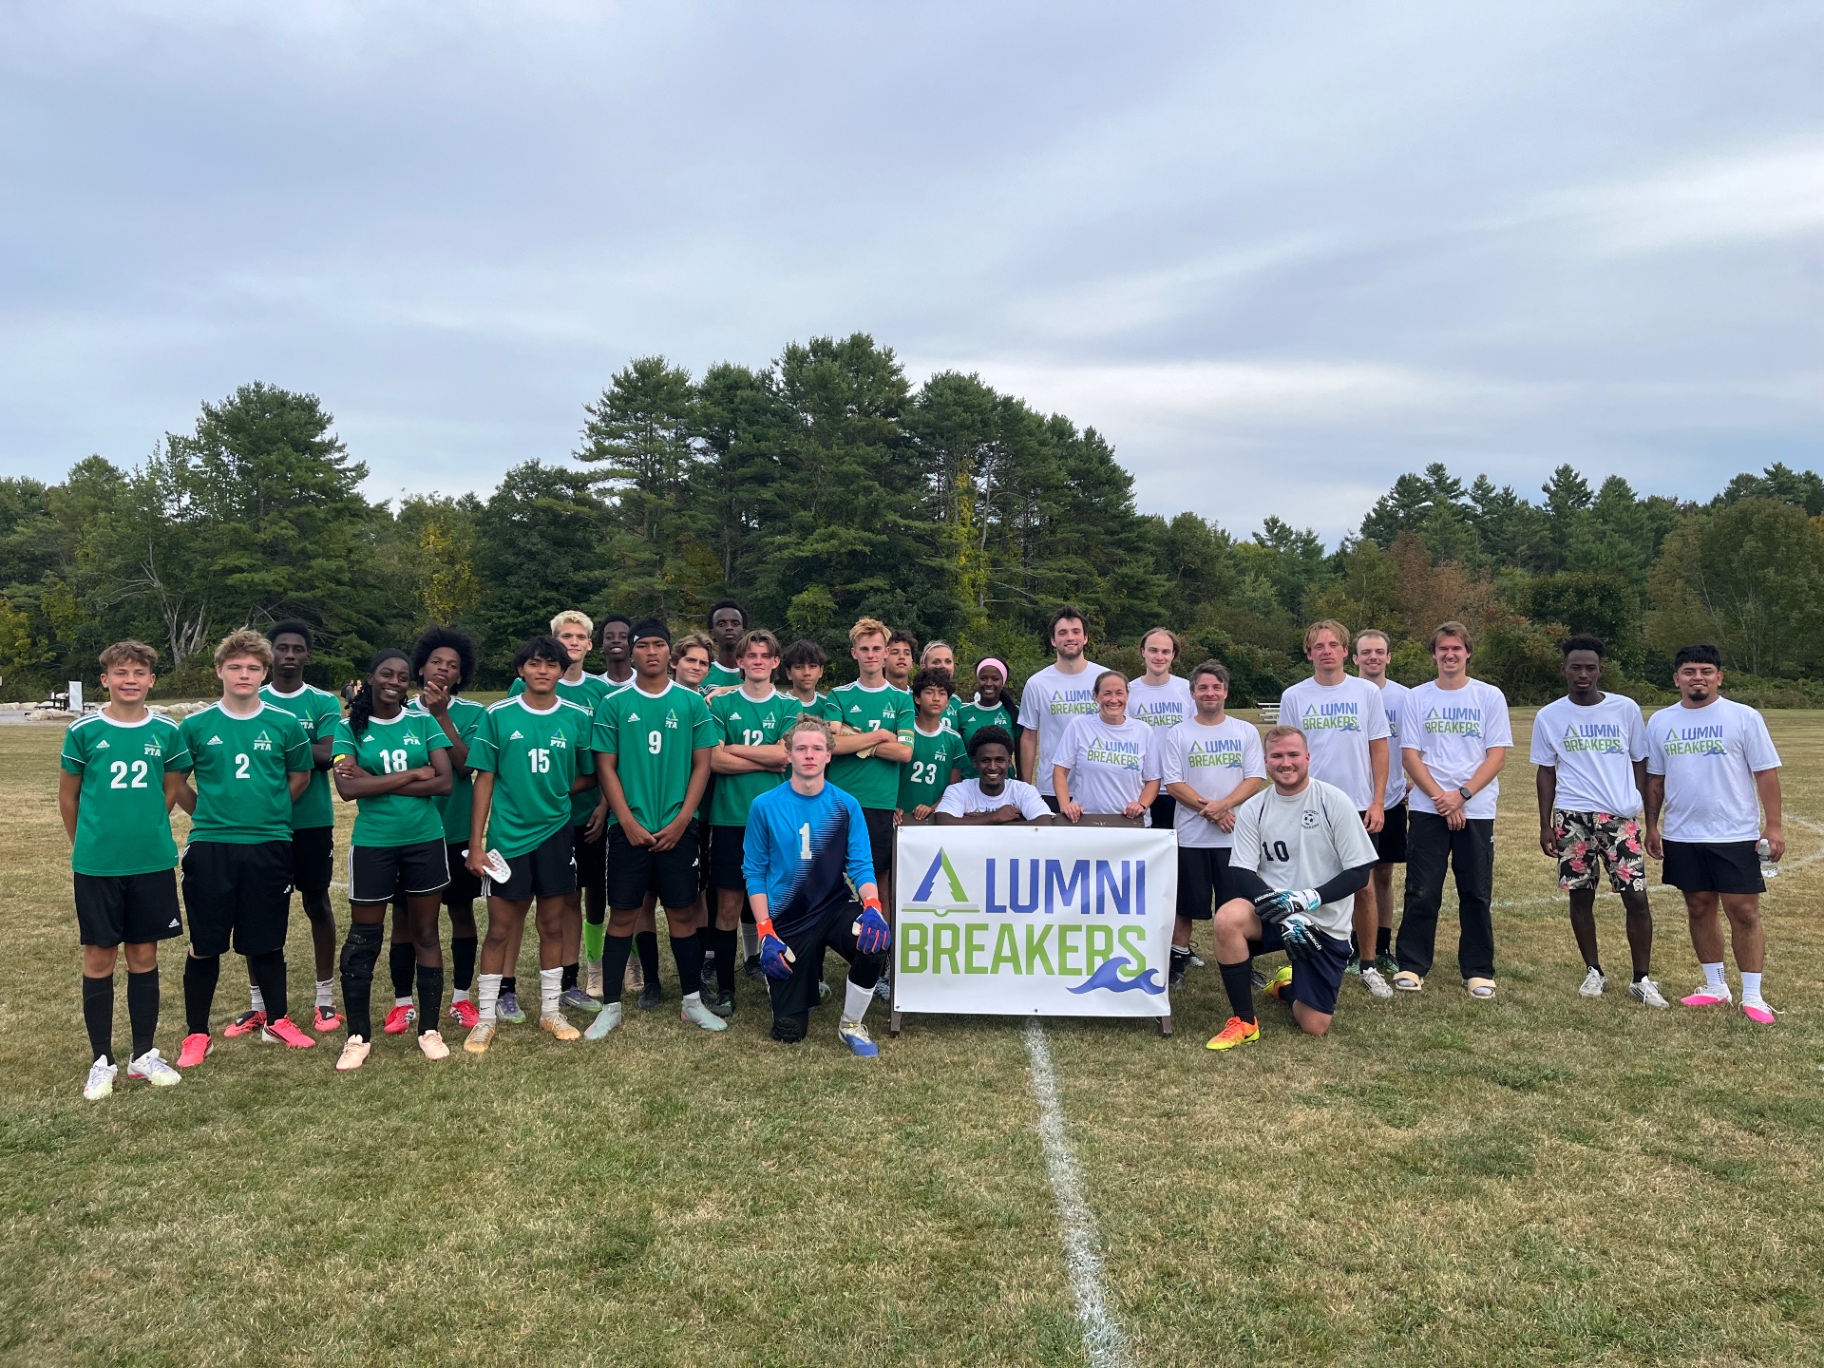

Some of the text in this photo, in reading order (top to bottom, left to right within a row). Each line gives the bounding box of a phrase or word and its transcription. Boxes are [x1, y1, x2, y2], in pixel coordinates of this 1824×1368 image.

[1303, 716, 1358, 730] BREAKERS
[1425, 721, 1480, 734] BREAKERS
[648, 730, 662, 754] 9
[742, 729, 763, 746] 12
[1563, 739, 1621, 752] BREAKERS
[1664, 740, 1723, 756] BREAKERS
[235, 753, 250, 779] 2
[379, 749, 408, 774] 18
[528, 748, 550, 773] 15
[1087, 750, 1139, 766] BREAKERS
[1188, 753, 1242, 768] BREAKERS
[110, 760, 148, 789] 22
[910, 761, 937, 784] 23
[799, 823, 812, 860] 1
[1262, 841, 1289, 862] 10
[900, 922, 1146, 976] BREAKERS
